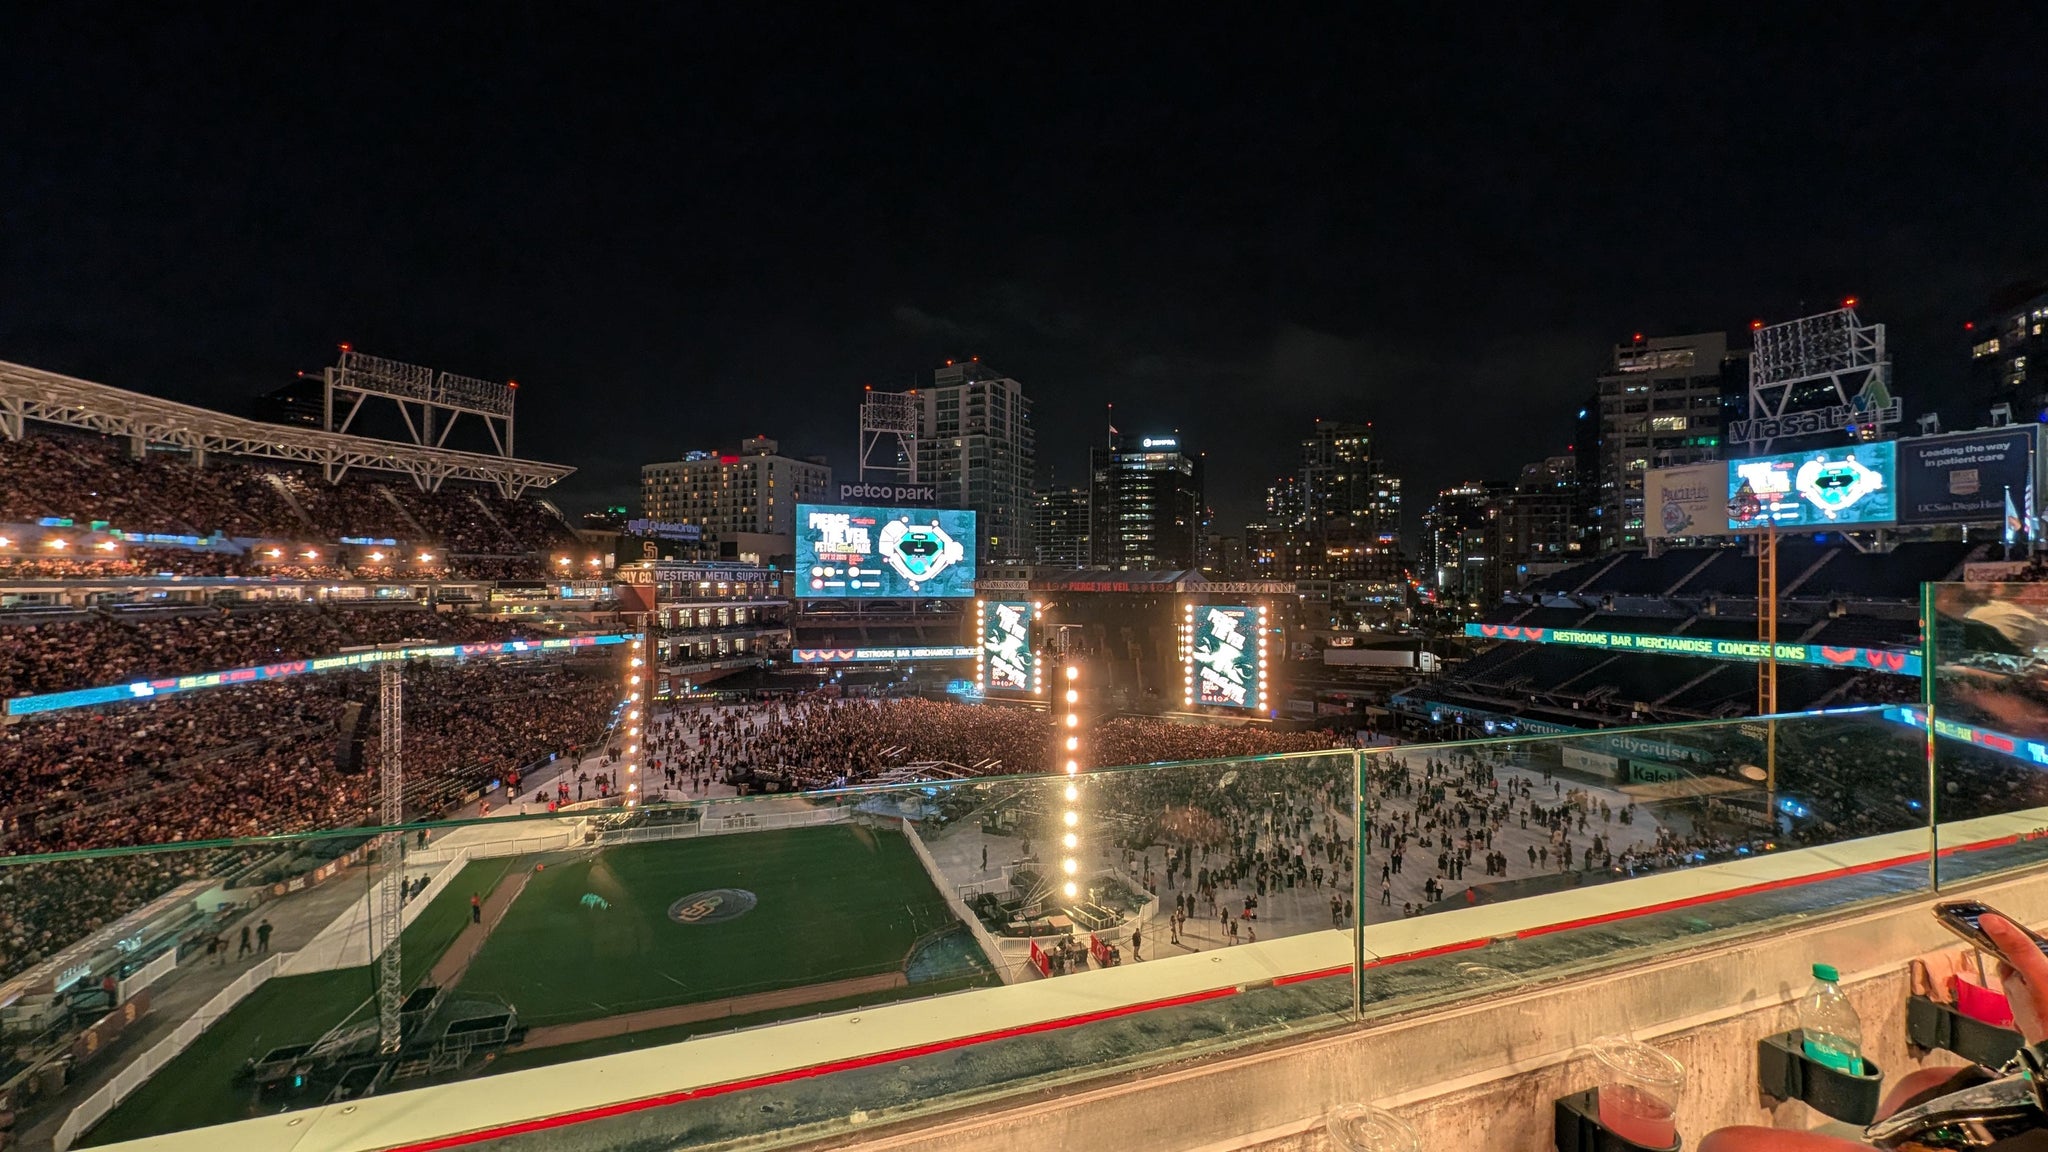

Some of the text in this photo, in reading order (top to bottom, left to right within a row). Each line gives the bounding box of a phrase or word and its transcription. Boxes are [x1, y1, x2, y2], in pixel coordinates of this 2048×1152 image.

[1732, 407, 1836, 441] Viasat
[1919, 441, 2010, 458] Leading the way
[1924, 453, 2005, 467] in patient care
[840, 484, 935, 502] petco park
[1952, 501, 1981, 512] Diego
[656, 570, 700, 581] WESTERN
[705, 571, 734, 581] METAL
[737, 572, 767, 581] SUPPLY
[1069, 582, 1129, 592] PIERCE THE VEIL
[1553, 631, 1805, 660] RESTROOMS BAR MERCHANDISE CONCESSONS
